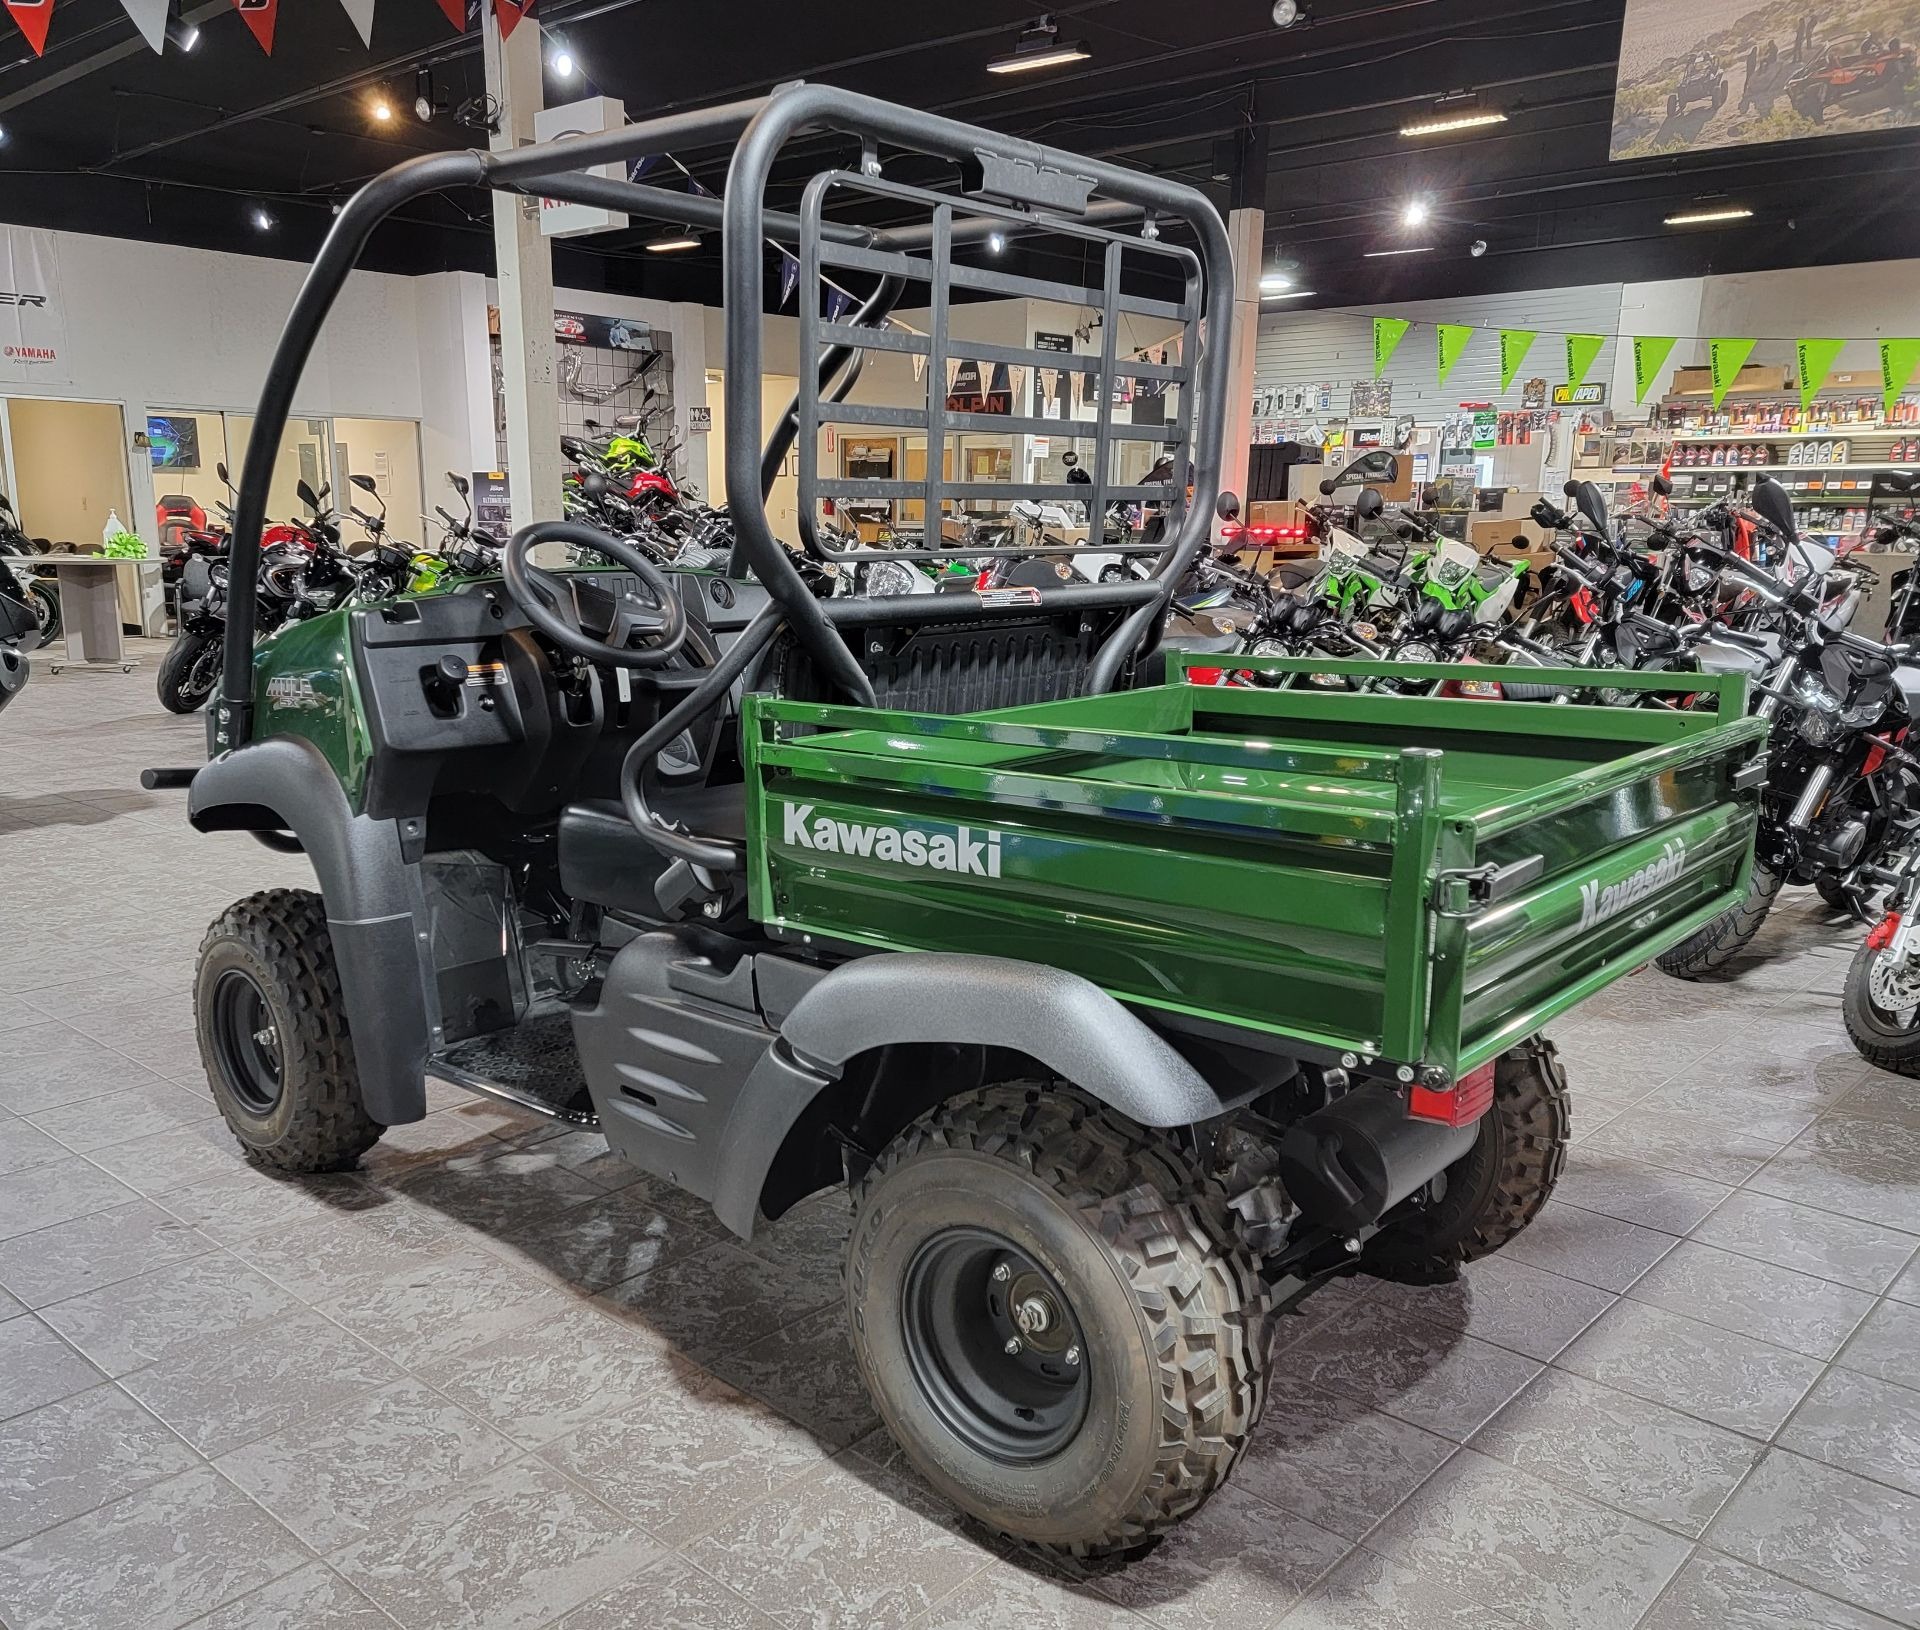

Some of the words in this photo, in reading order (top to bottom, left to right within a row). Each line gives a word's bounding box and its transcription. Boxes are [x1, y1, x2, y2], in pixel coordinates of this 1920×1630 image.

[15, 346, 56, 360] YAMAHA
[1567, 338, 1575, 381] Kawasaki
[1634, 341, 1645, 385] Kawasaki
[1711, 343, 1722, 388] Kawasaki
[1799, 344, 1810, 390] Kawasaki
[1881, 344, 1894, 391] Kawasaki
[266, 677, 314, 698] MULE
[784, 801, 1001, 879] Kawasaki
[1577, 837, 1686, 933] Kawasaki
